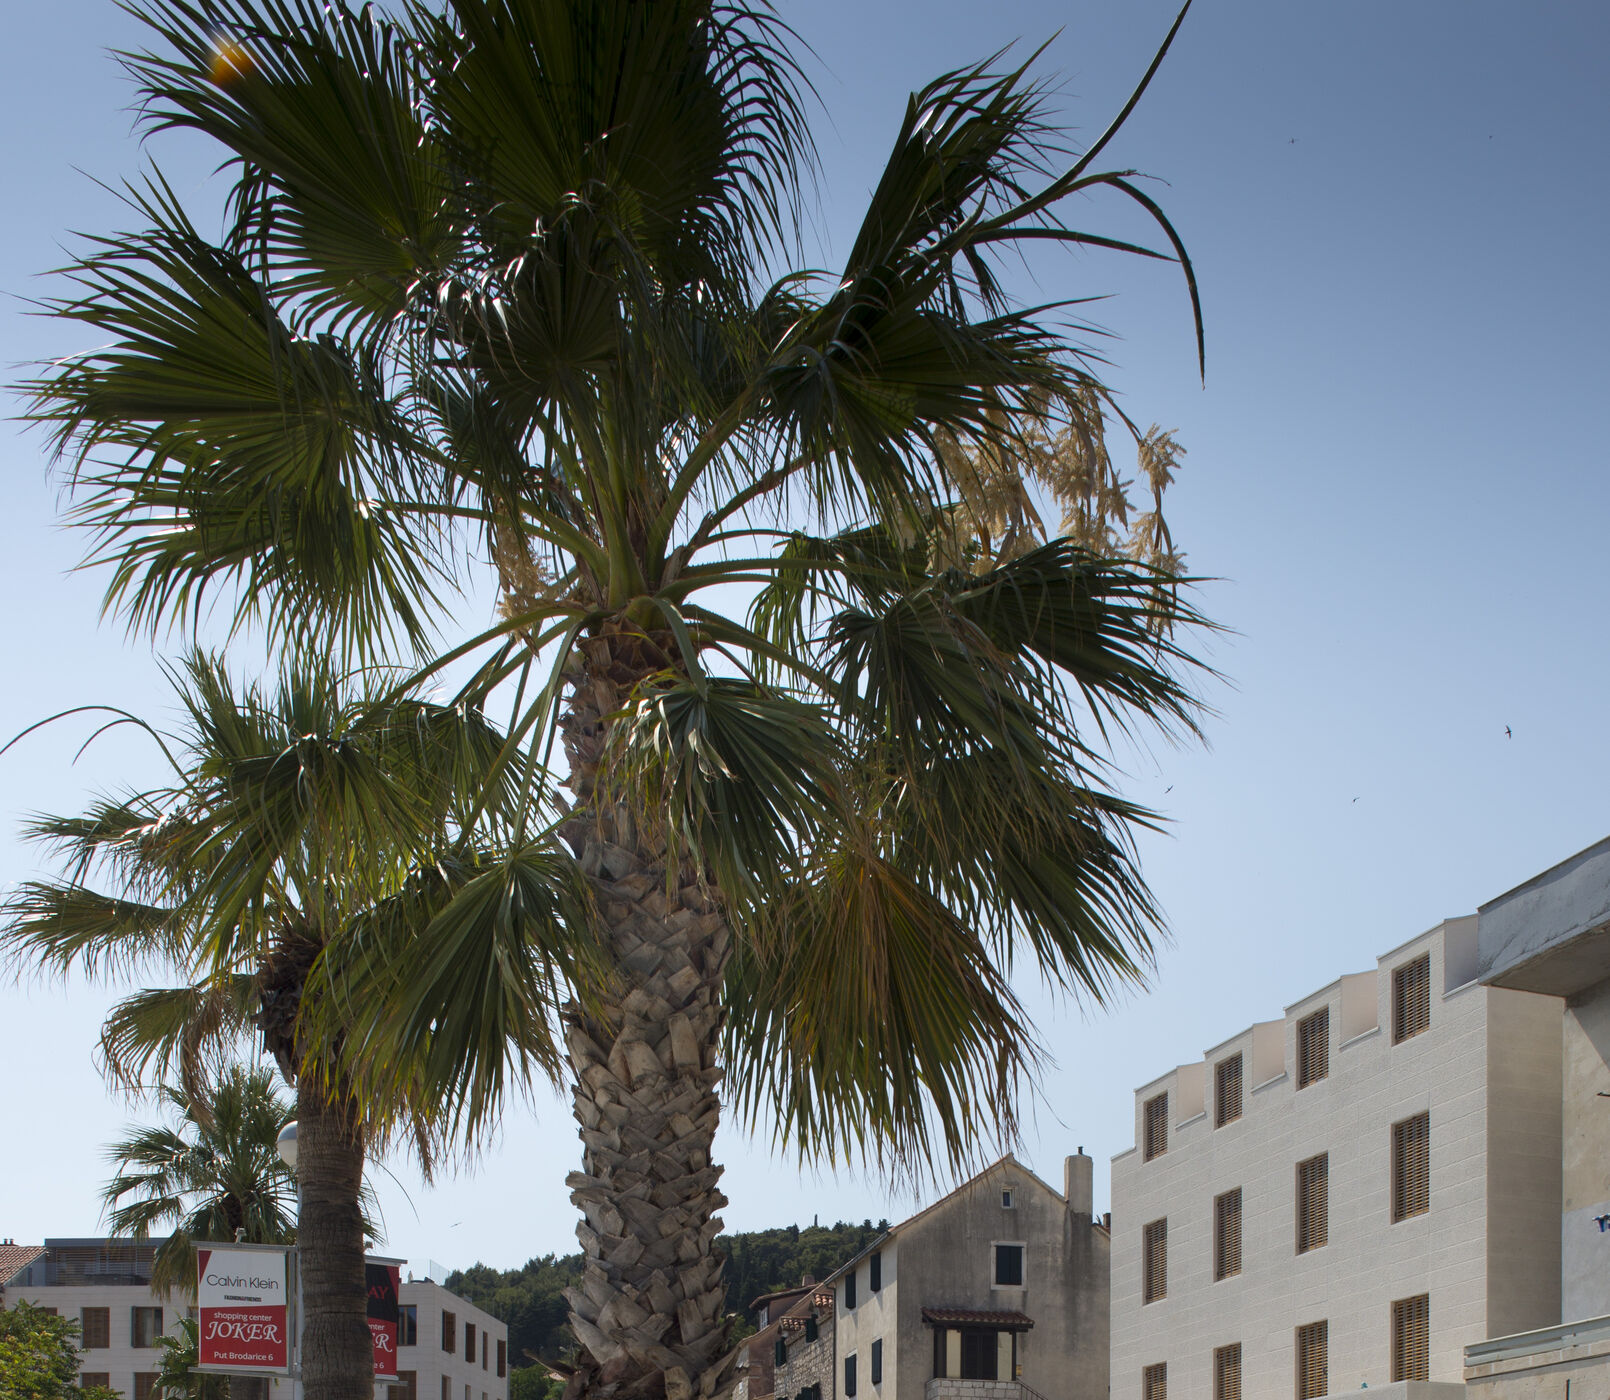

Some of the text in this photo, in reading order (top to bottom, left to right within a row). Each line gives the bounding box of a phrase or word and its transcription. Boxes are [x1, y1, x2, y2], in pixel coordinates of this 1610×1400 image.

[206, 1274, 279, 1289] Calvin Klein
[368, 1285, 388, 1299] AY
[214, 1312, 273, 1322] shopping center
[205, 1321, 282, 1344] JOKER
[214, 1351, 228, 1360] Put
[229, 1352, 267, 1361] Brodarice
